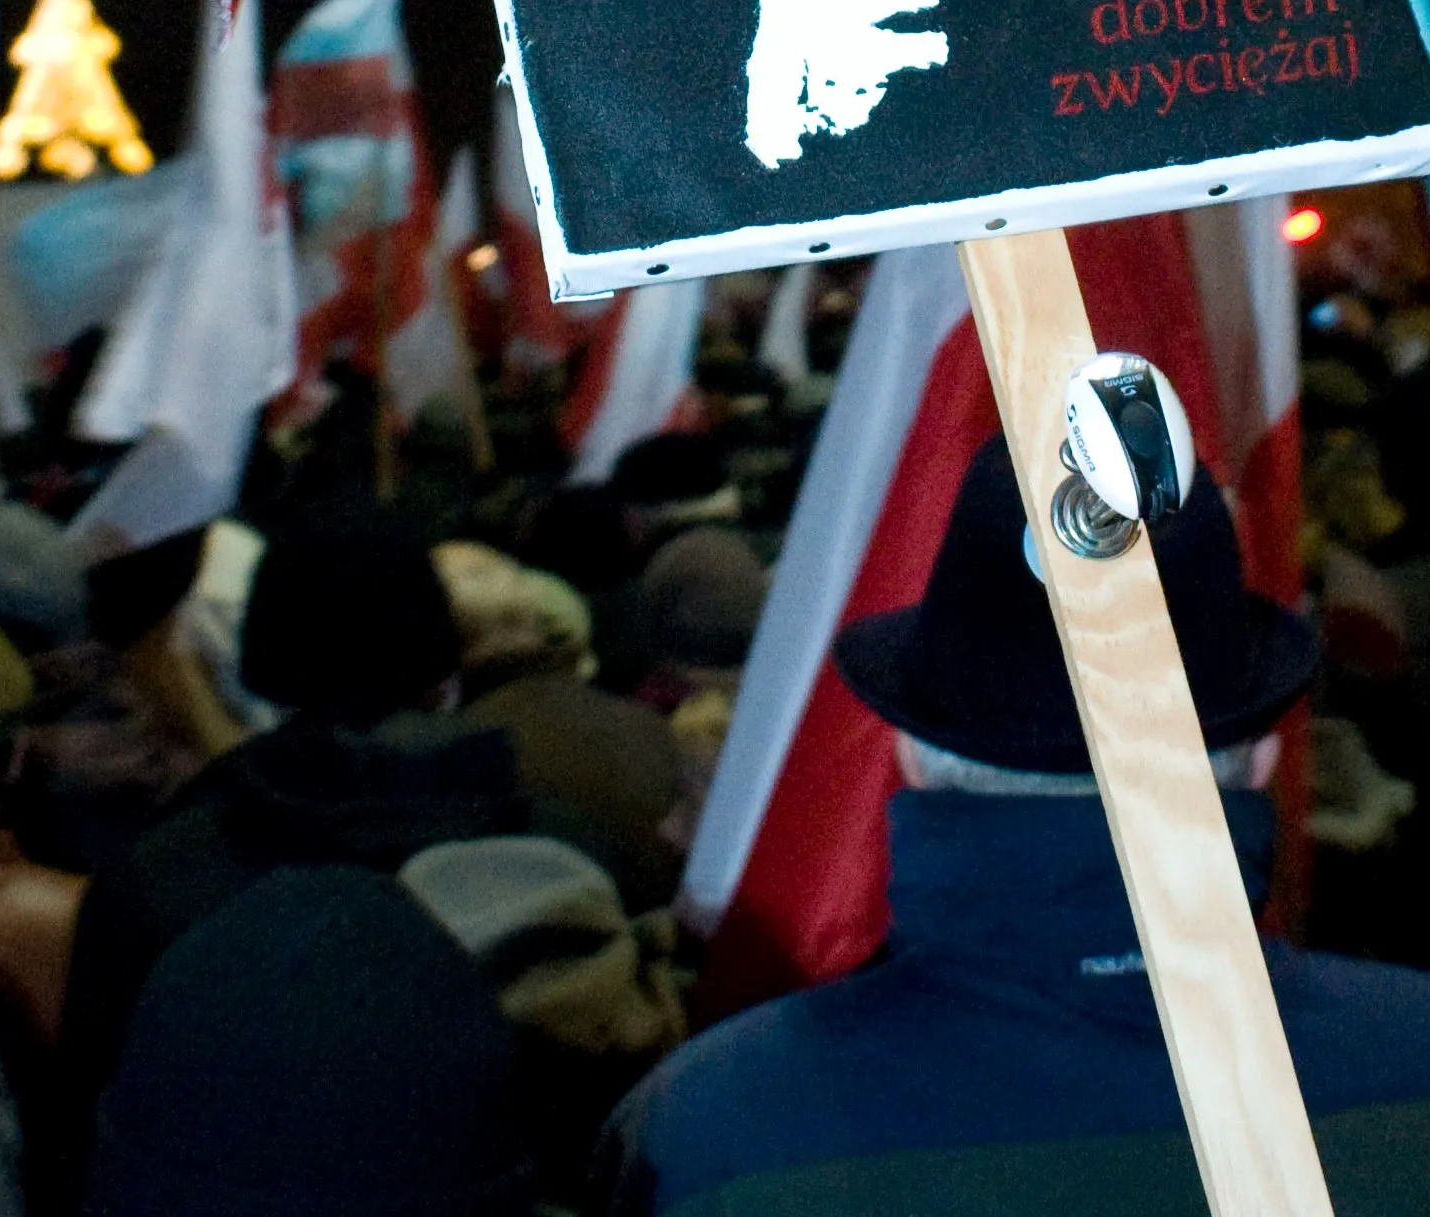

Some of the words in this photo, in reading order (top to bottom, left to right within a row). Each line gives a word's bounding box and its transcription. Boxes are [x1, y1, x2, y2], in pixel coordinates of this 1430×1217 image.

[1050, 21, 1359, 116] zwyciężaj
[1103, 374, 1144, 388] SIGMA
[1072, 425, 1096, 472] SIGMA
